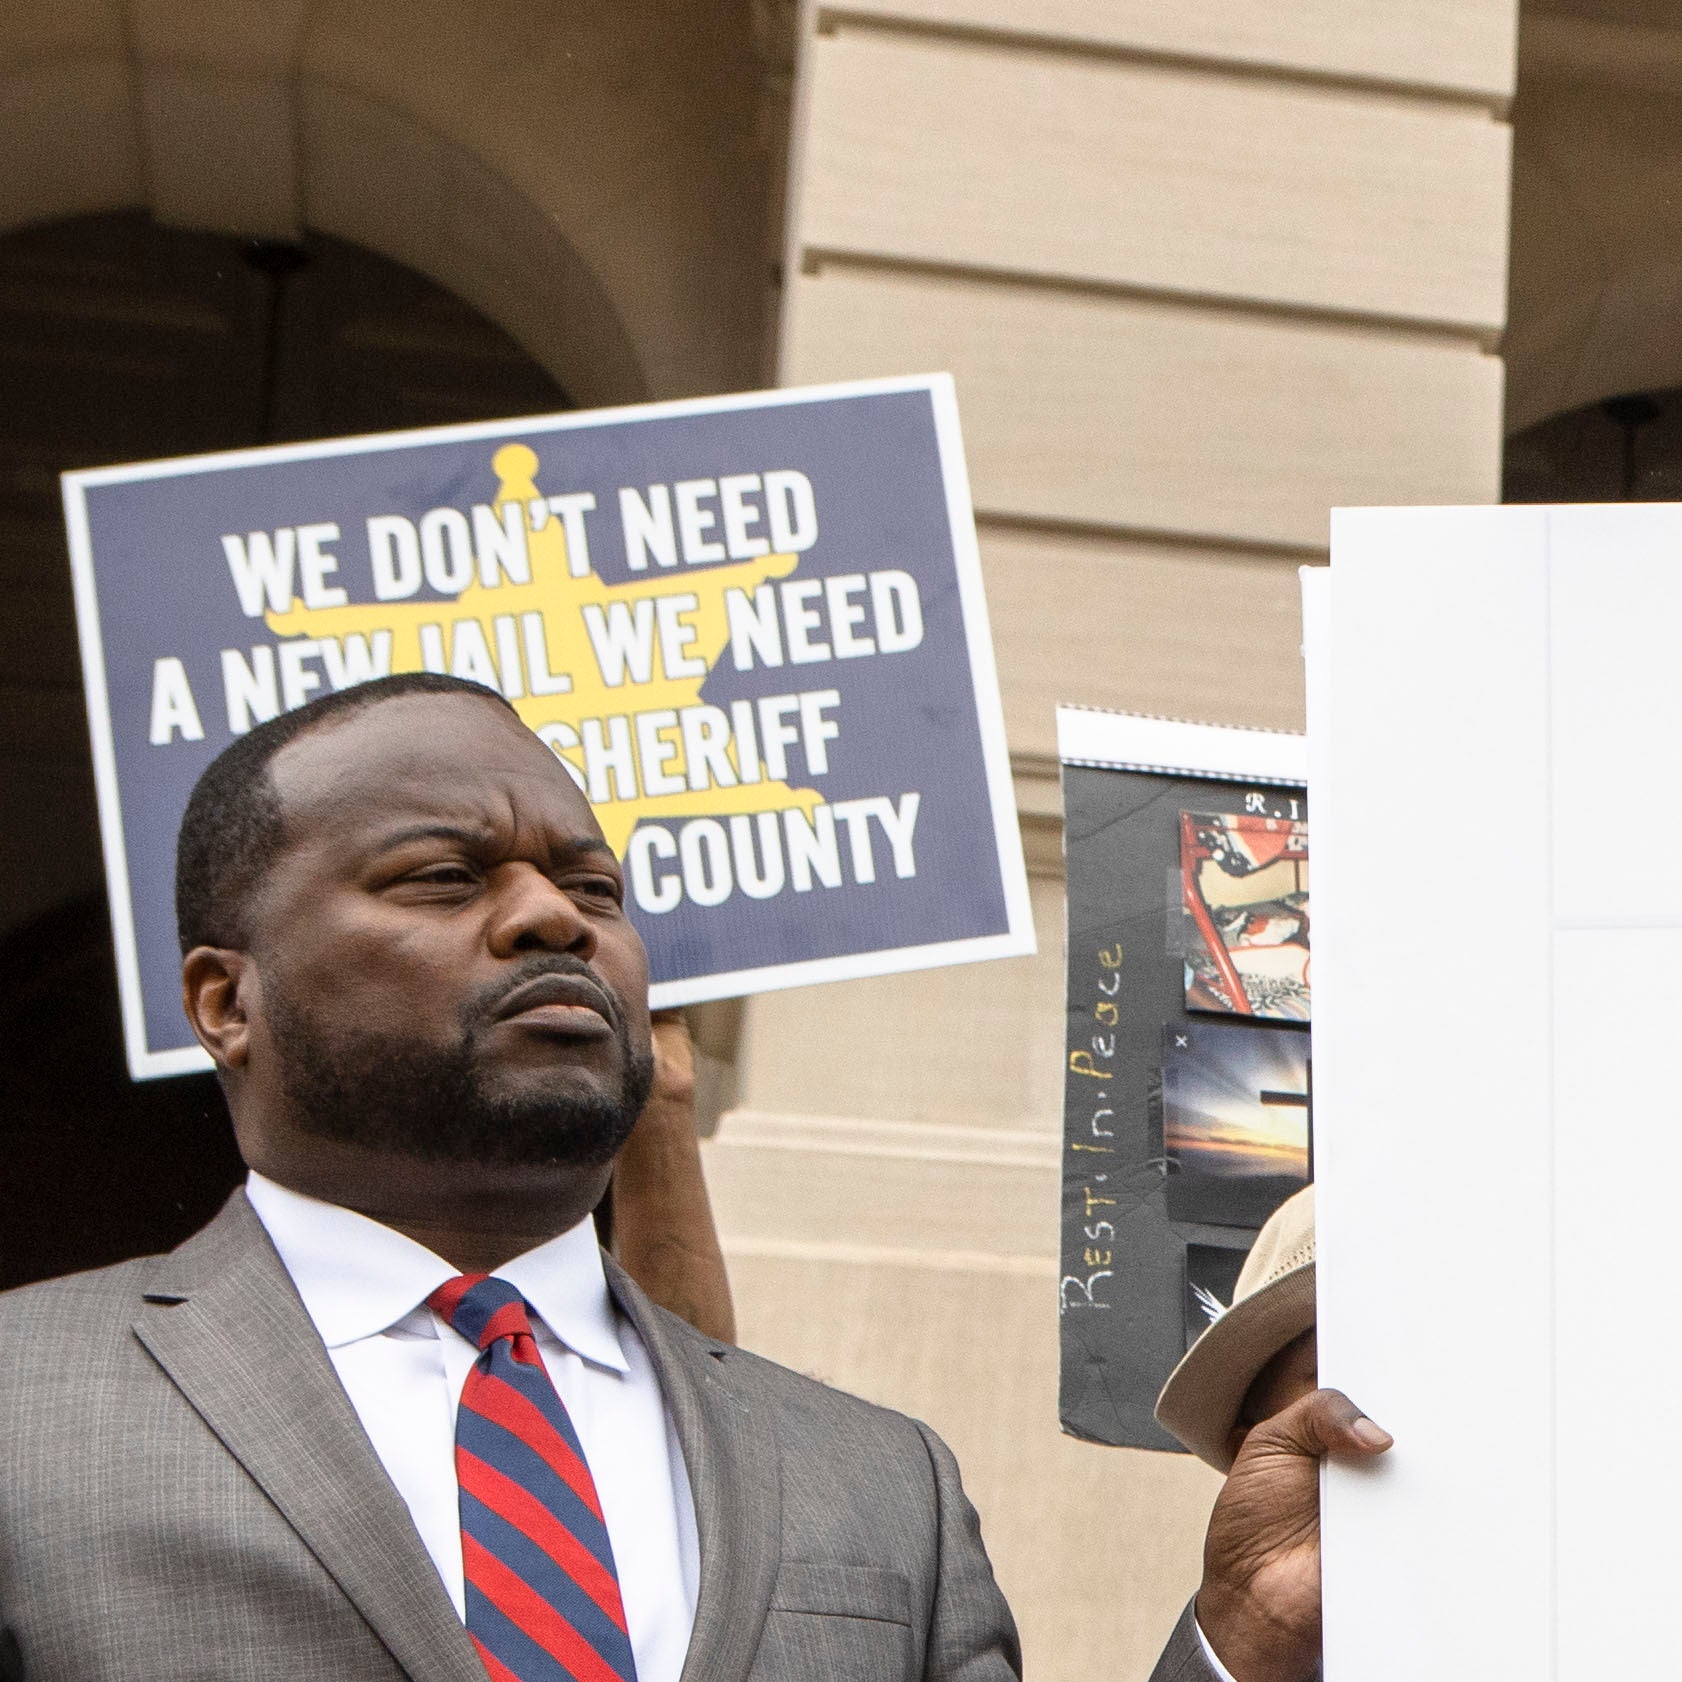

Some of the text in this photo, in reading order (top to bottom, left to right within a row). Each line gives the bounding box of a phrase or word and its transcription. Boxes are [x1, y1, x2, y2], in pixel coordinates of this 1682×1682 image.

[221, 470, 818, 617] WE DON'T NEED
[150, 657, 204, 744] A
[583, 594, 706, 687] WE
[725, 570, 923, 671] NEED
[628, 792, 920, 913] COUNTY
